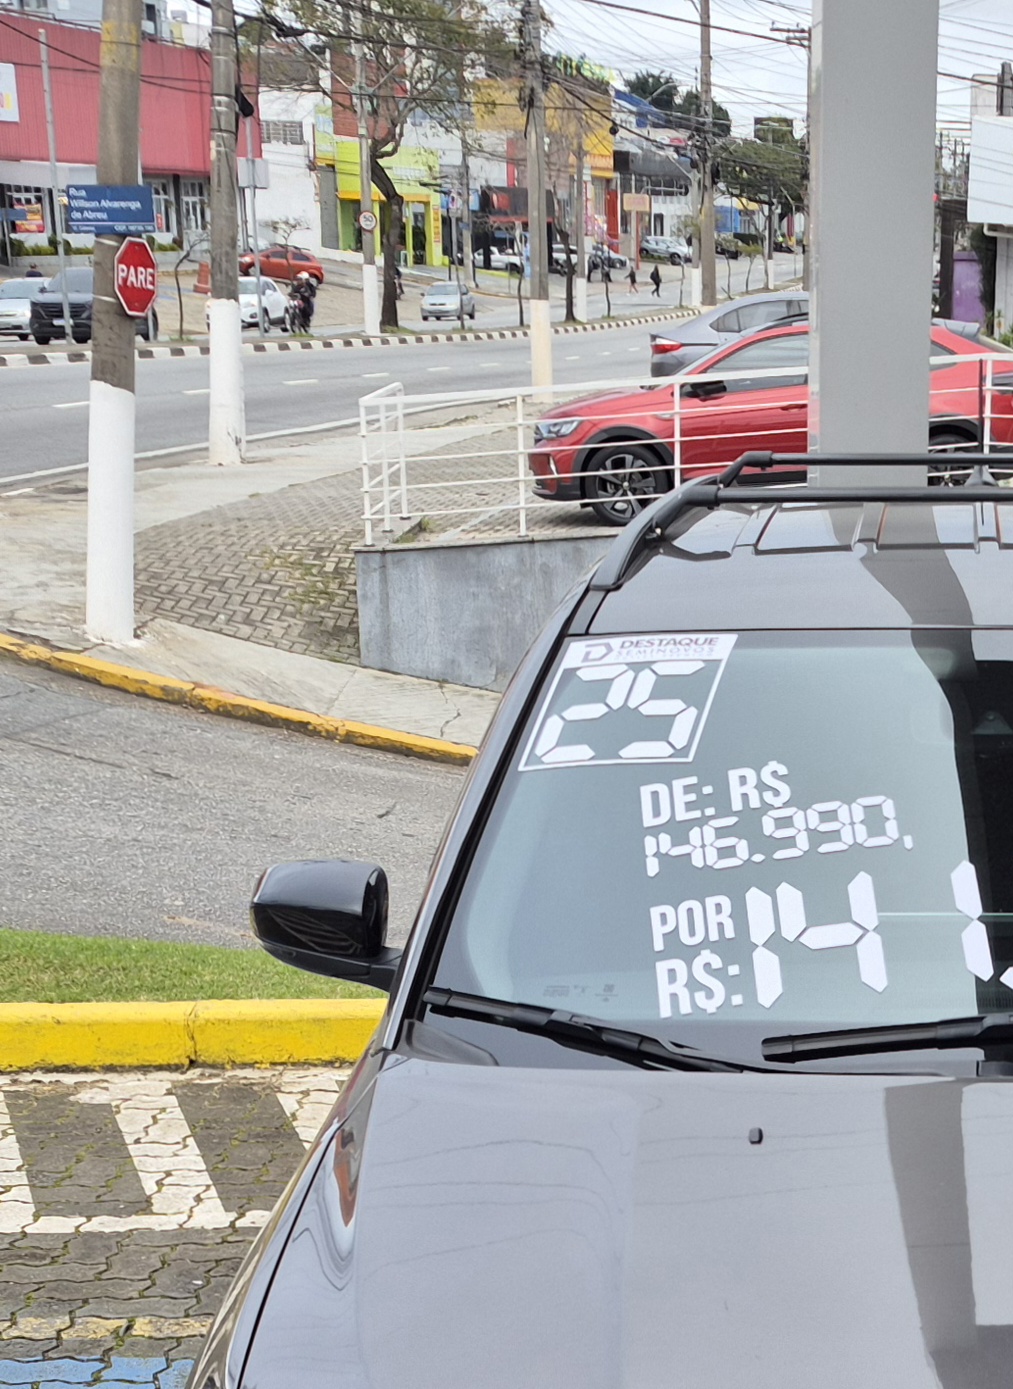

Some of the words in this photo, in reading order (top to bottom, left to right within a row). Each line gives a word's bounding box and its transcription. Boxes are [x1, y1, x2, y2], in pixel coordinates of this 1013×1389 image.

[69, 187, 86, 198] Rua
[100, 199, 142, 211] Alvarenga
[71, 210, 82, 220] de
[83, 210, 108, 220] Abreu
[118, 264, 155, 290] PARE
[616, 647, 715, 657] SEMINOVOS
[620, 636, 719, 649] DESTAQUE
[534, 660, 706, 763] 25
[640, 776, 716, 828] DE:
[727, 760, 791, 811] R$
[649, 894, 736, 952] POR
[655, 949, 743, 1018] R$:
